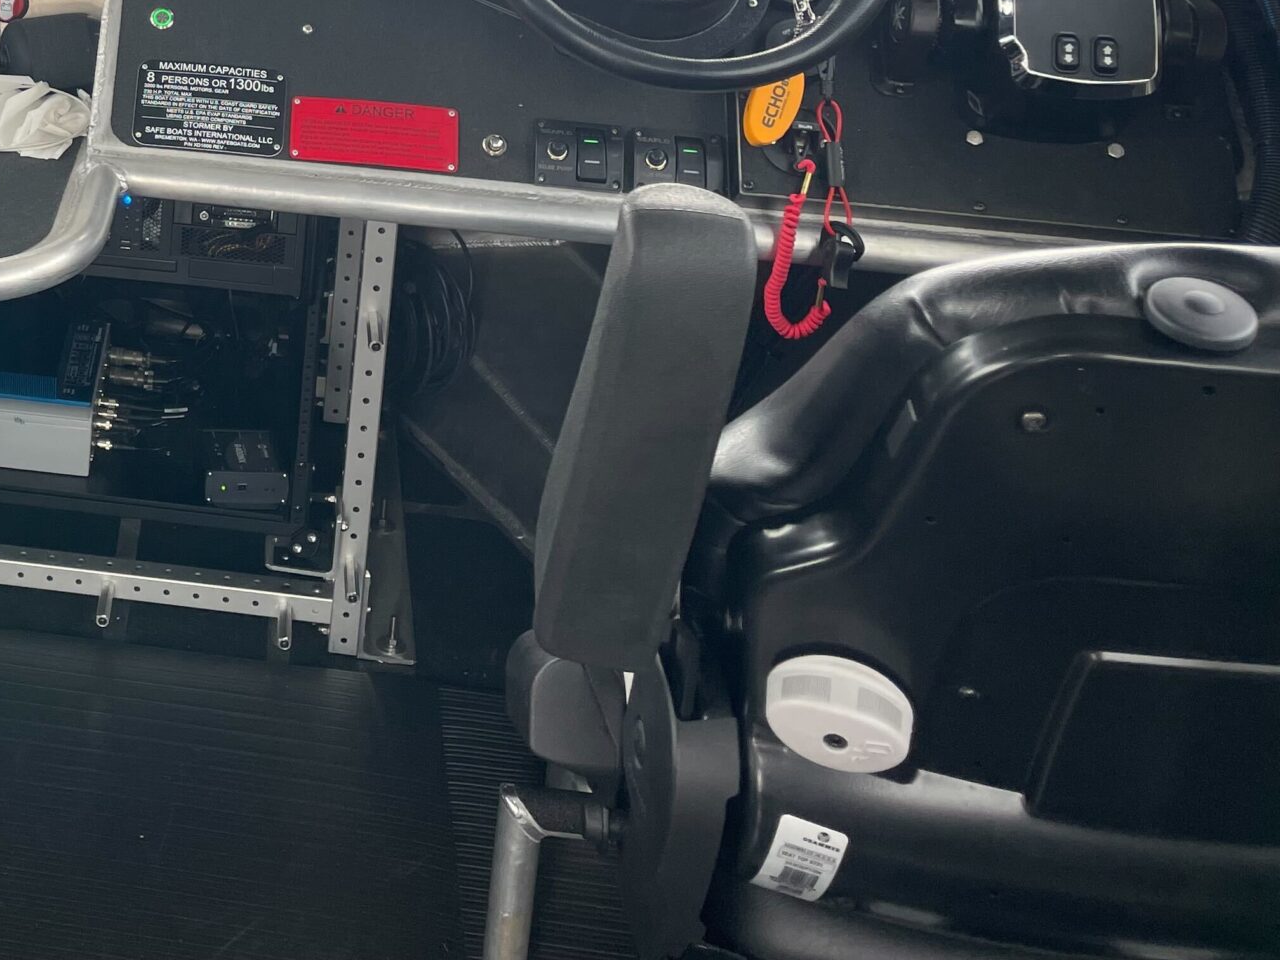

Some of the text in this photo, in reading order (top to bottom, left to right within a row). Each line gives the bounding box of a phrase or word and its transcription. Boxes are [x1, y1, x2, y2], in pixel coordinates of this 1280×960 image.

[159, 62, 268, 79] MAXIMUM CAPACITIES
[146, 71, 155, 83] 8
[162, 75, 210, 87] PERSONS
[211, 79, 227, 88] OR
[241, 108, 280, 117] CERTIFICATION
[352, 103, 416, 120] DANGER
[183, 121, 221, 131] STORMER
[210, 117, 247, 125] COMPONENTS
[145, 126, 273, 144] SAFE BOATS INTERNATIONAL, LLC
[201, 138, 261, 149] WWW.SAFEBOATS.COM
